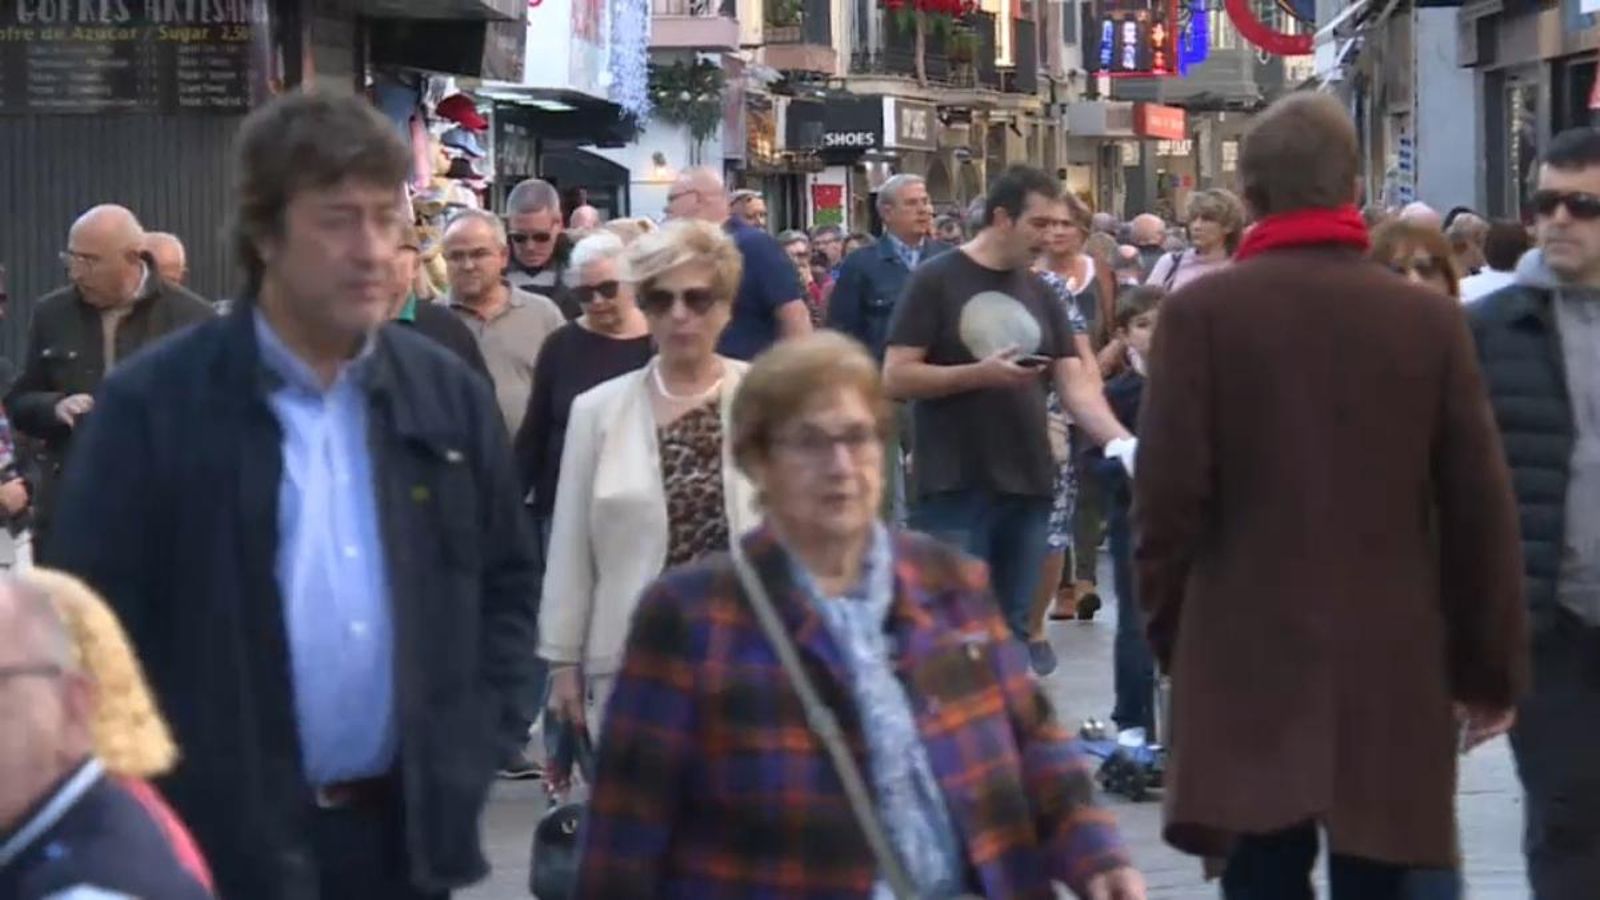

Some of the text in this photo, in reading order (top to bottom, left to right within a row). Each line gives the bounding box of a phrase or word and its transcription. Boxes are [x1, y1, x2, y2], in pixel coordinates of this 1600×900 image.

[40, 26, 64, 41] de
[158, 26, 208, 43] Sugar
[825, 132, 874, 147] SHOES
